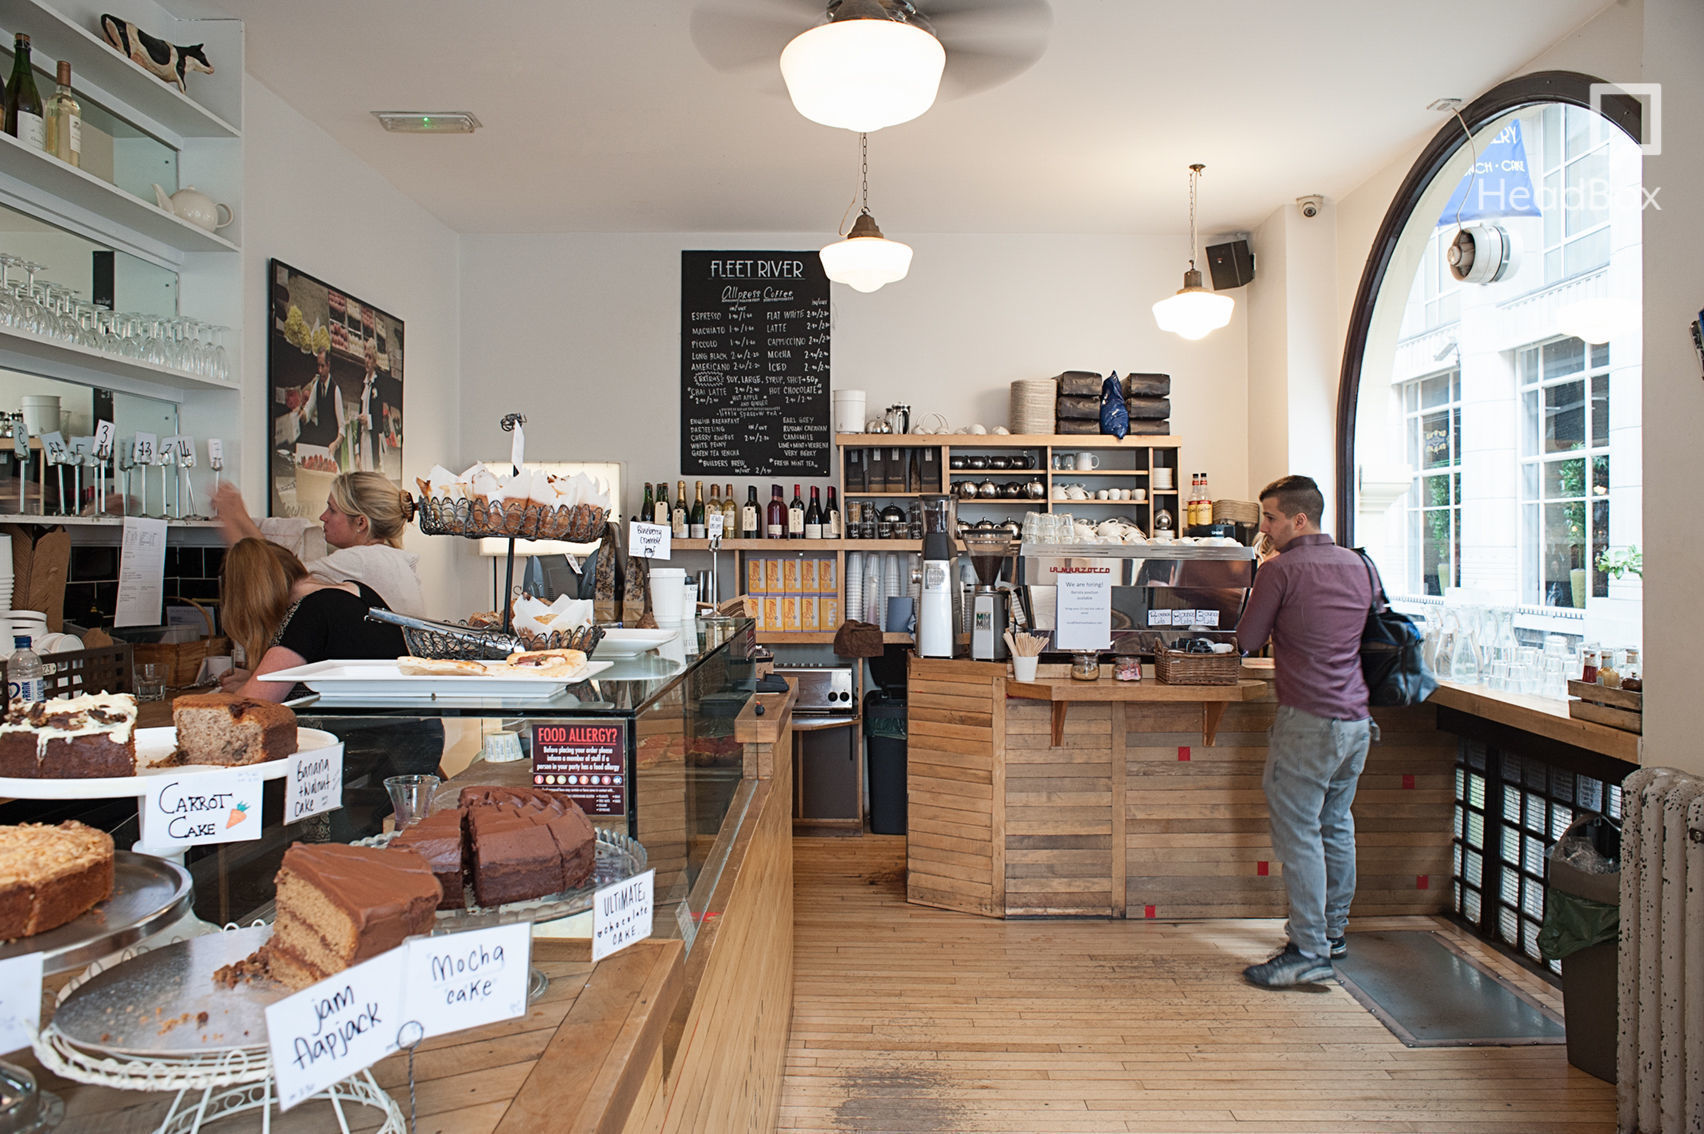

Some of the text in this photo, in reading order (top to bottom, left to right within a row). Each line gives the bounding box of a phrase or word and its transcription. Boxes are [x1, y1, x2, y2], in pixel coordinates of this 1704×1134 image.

[711, 260, 803, 277] FLEET RIVER
[764, 286, 793, 300] Coffee
[692, 312, 721, 320] ESPRESSO
[766, 311, 780, 320] FLAT
[784, 309, 804, 319] WHITE
[766, 323, 787, 333] LATTE
[692, 340, 718, 348] PICCOLO
[768, 336, 806, 346] CAPPUCCINO
[768, 350, 792, 358] MOCHA
[691, 362, 730, 370] AMERICANO
[768, 362, 787, 372] ICED
[708, 388, 727, 396] LATTE
[769, 386, 816, 395] HOT CHOCOLATE
[538, 728, 618, 742] FOOD ALLERGY?
[559, 746, 574, 754] placing
[605, 763, 620, 772] allergy
[158, 782, 232, 814] CARROT
[168, 816, 216, 839] CAKE
[604, 906, 648, 934] chocolate
[310, 985, 356, 1036] jam
[292, 1002, 384, 1070] flapjack
